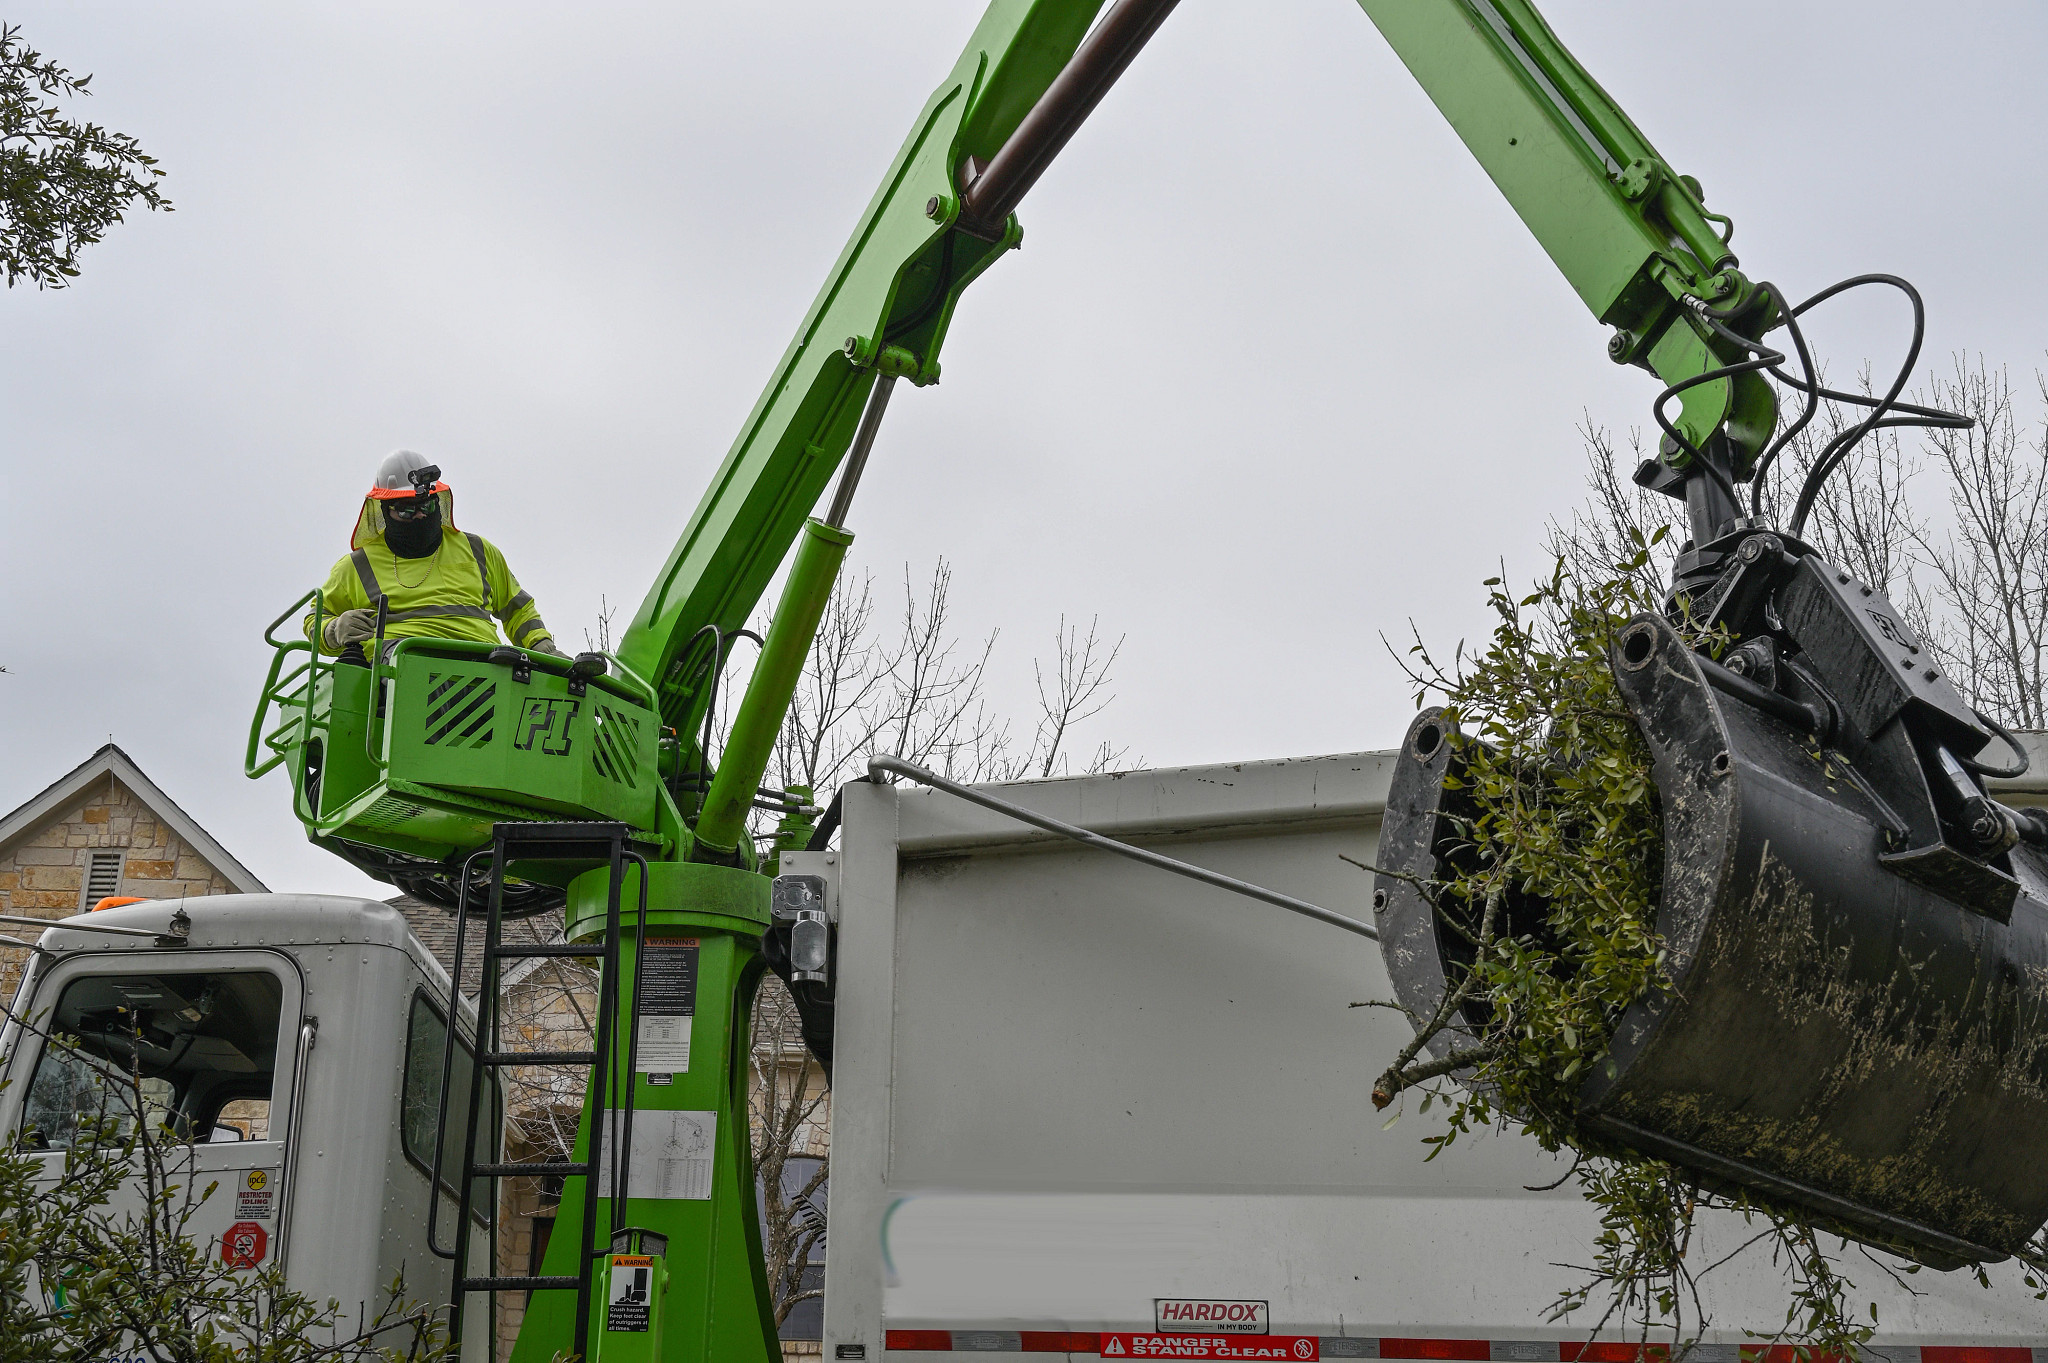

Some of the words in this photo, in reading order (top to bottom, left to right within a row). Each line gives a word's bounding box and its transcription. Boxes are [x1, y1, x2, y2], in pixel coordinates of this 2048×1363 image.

[650, 938, 696, 946] WARNING
[1226, 1323, 1237, 1331] MY
[1132, 1337, 1227, 1347] DANGER
[1132, 1346, 1209, 1356] STAND
[1216, 1347, 1287, 1357] CLEAR
